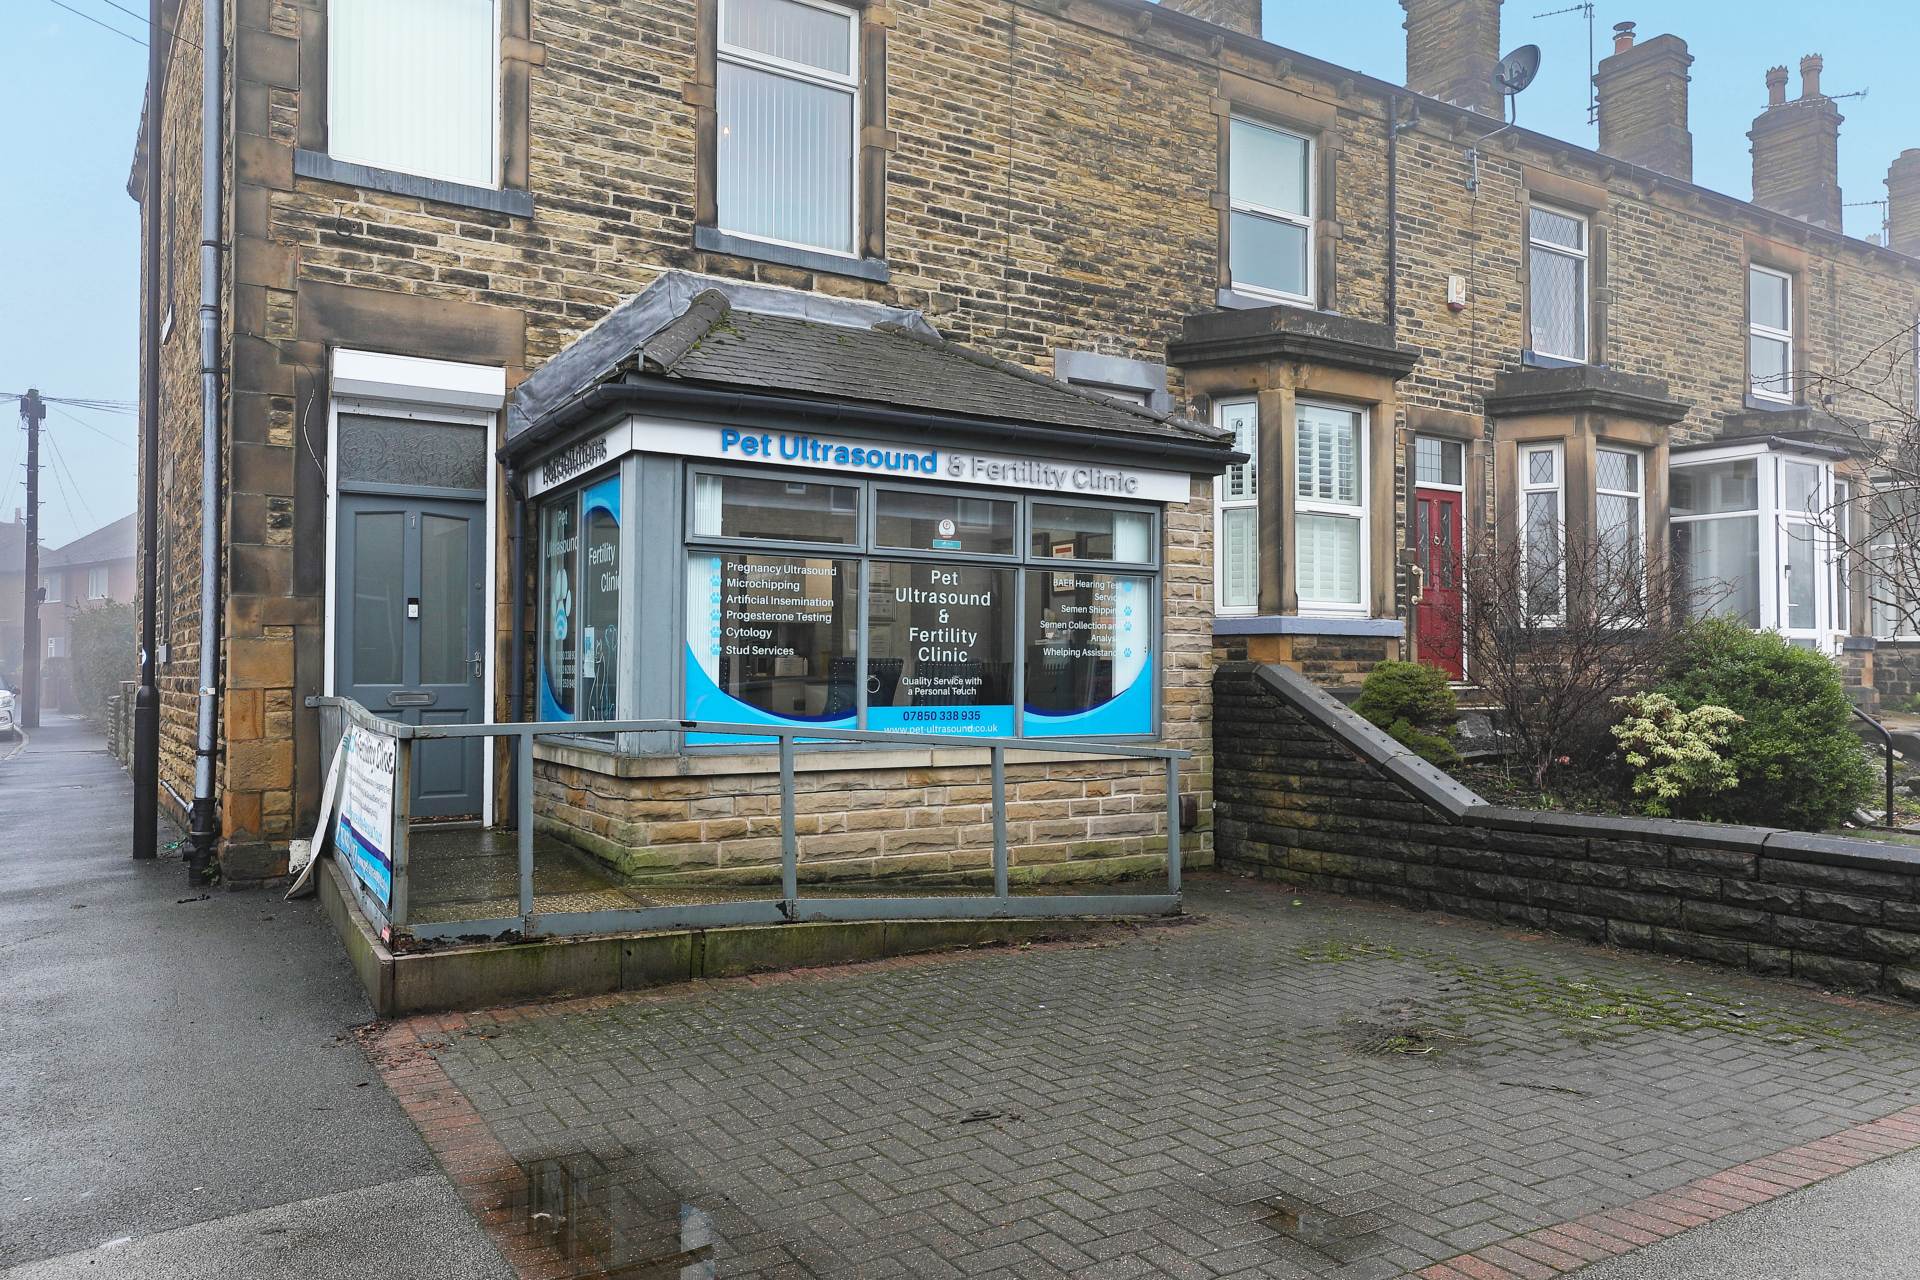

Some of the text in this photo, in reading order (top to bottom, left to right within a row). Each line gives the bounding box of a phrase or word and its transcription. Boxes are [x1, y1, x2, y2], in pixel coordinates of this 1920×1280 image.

[721, 428, 1139, 494] Pet Ultrasound & Fertility Clinic
[589, 541, 616, 567] Fertility
[727, 562, 837, 576] Pregnancy Ultrasound
[727, 578, 800, 592] Microchipping
[931, 570, 959, 586] Pet
[1053, 579, 1075, 588] BAER
[1075, 580, 1105, 590] Hearing
[726, 594, 834, 608] Artificial Insemination
[895, 588, 991, 606] Ultrasound
[938, 608, 950, 624] &
[1061, 605, 1117, 615] Semen Shippin
[726, 610, 832, 625] Progesterone Testing
[1040, 620, 1067, 629] Semen
[1068, 620, 1107, 630] Collection
[726, 627, 772, 640] Cytology
[909, 627, 978, 648] Fertility
[726, 645, 795, 657] Stud Services
[918, 647, 968, 663] Clinic
[1043, 648, 1081, 658] Whelping
[902, 676, 982, 687] Quality Service with
[907, 687, 976, 697] a Personal Touch
[903, 710, 981, 721] 07850 338 935
